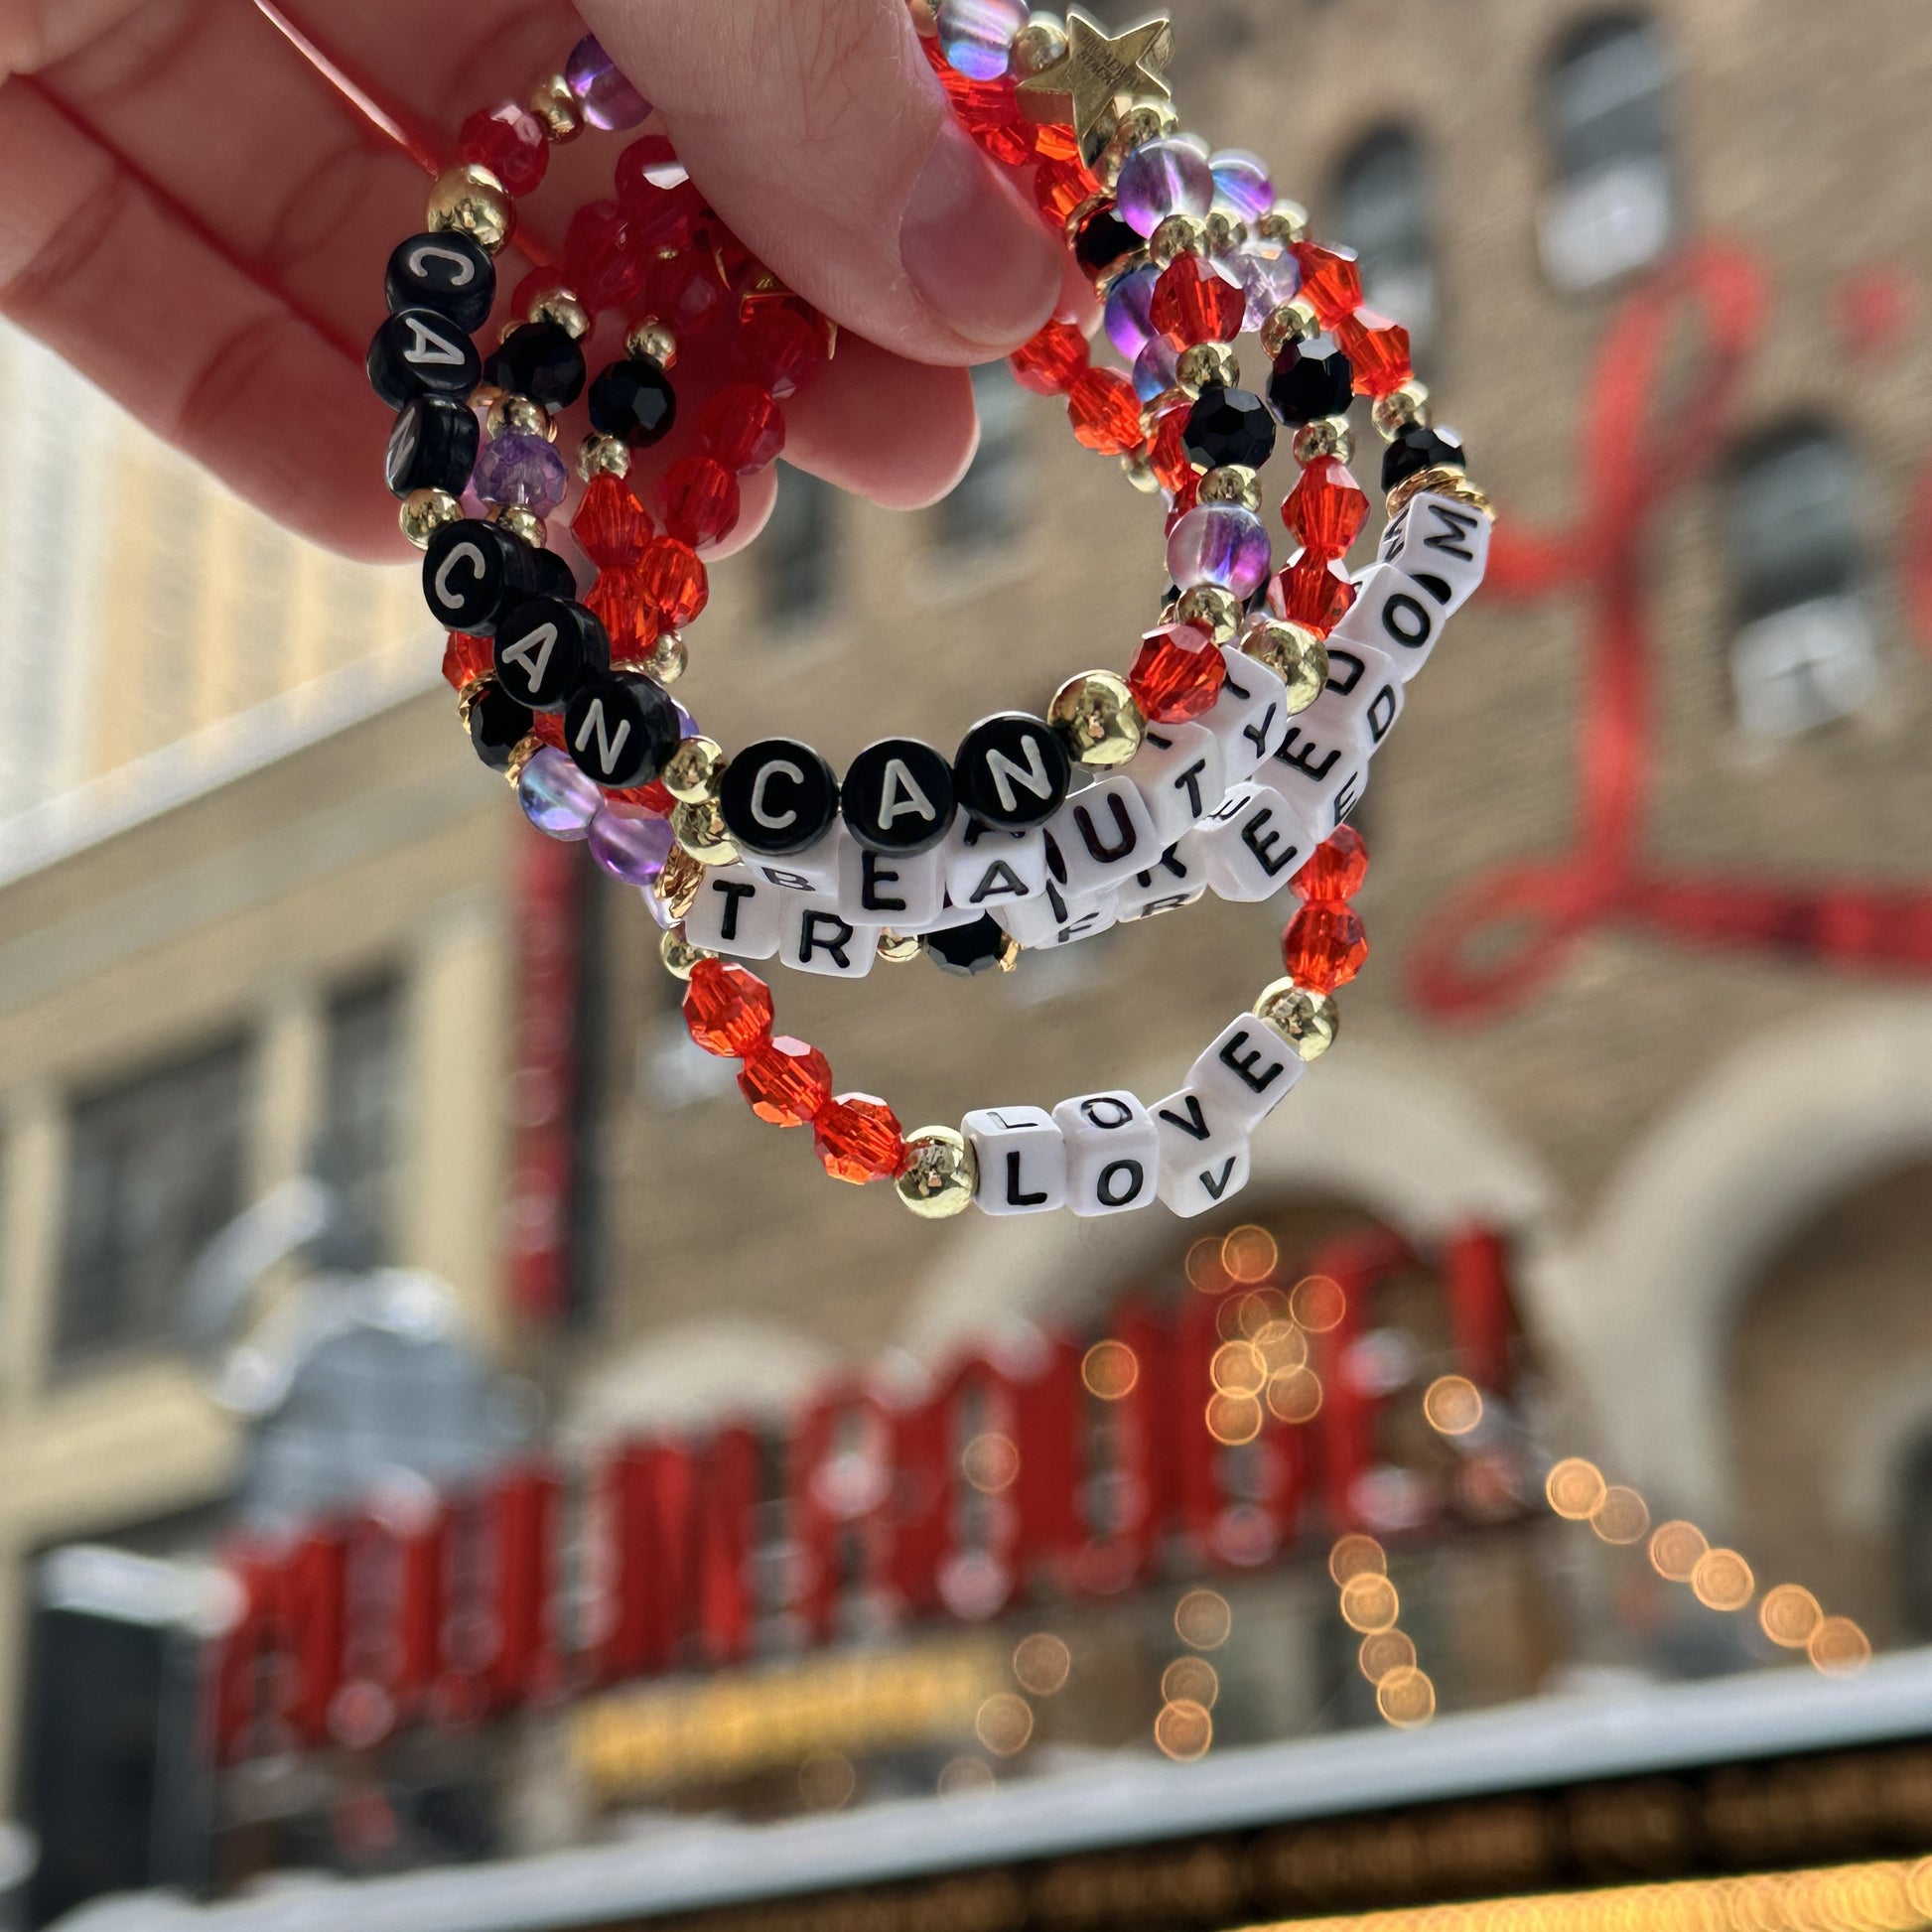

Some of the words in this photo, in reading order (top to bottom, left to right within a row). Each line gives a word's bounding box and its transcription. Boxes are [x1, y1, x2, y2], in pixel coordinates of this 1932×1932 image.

[386, 246, 476, 487] CAN
[435, 540, 631, 775] CAN
[750, 735, 1053, 830] CAN
[1003, 1031, 1285, 1207] LOVE
